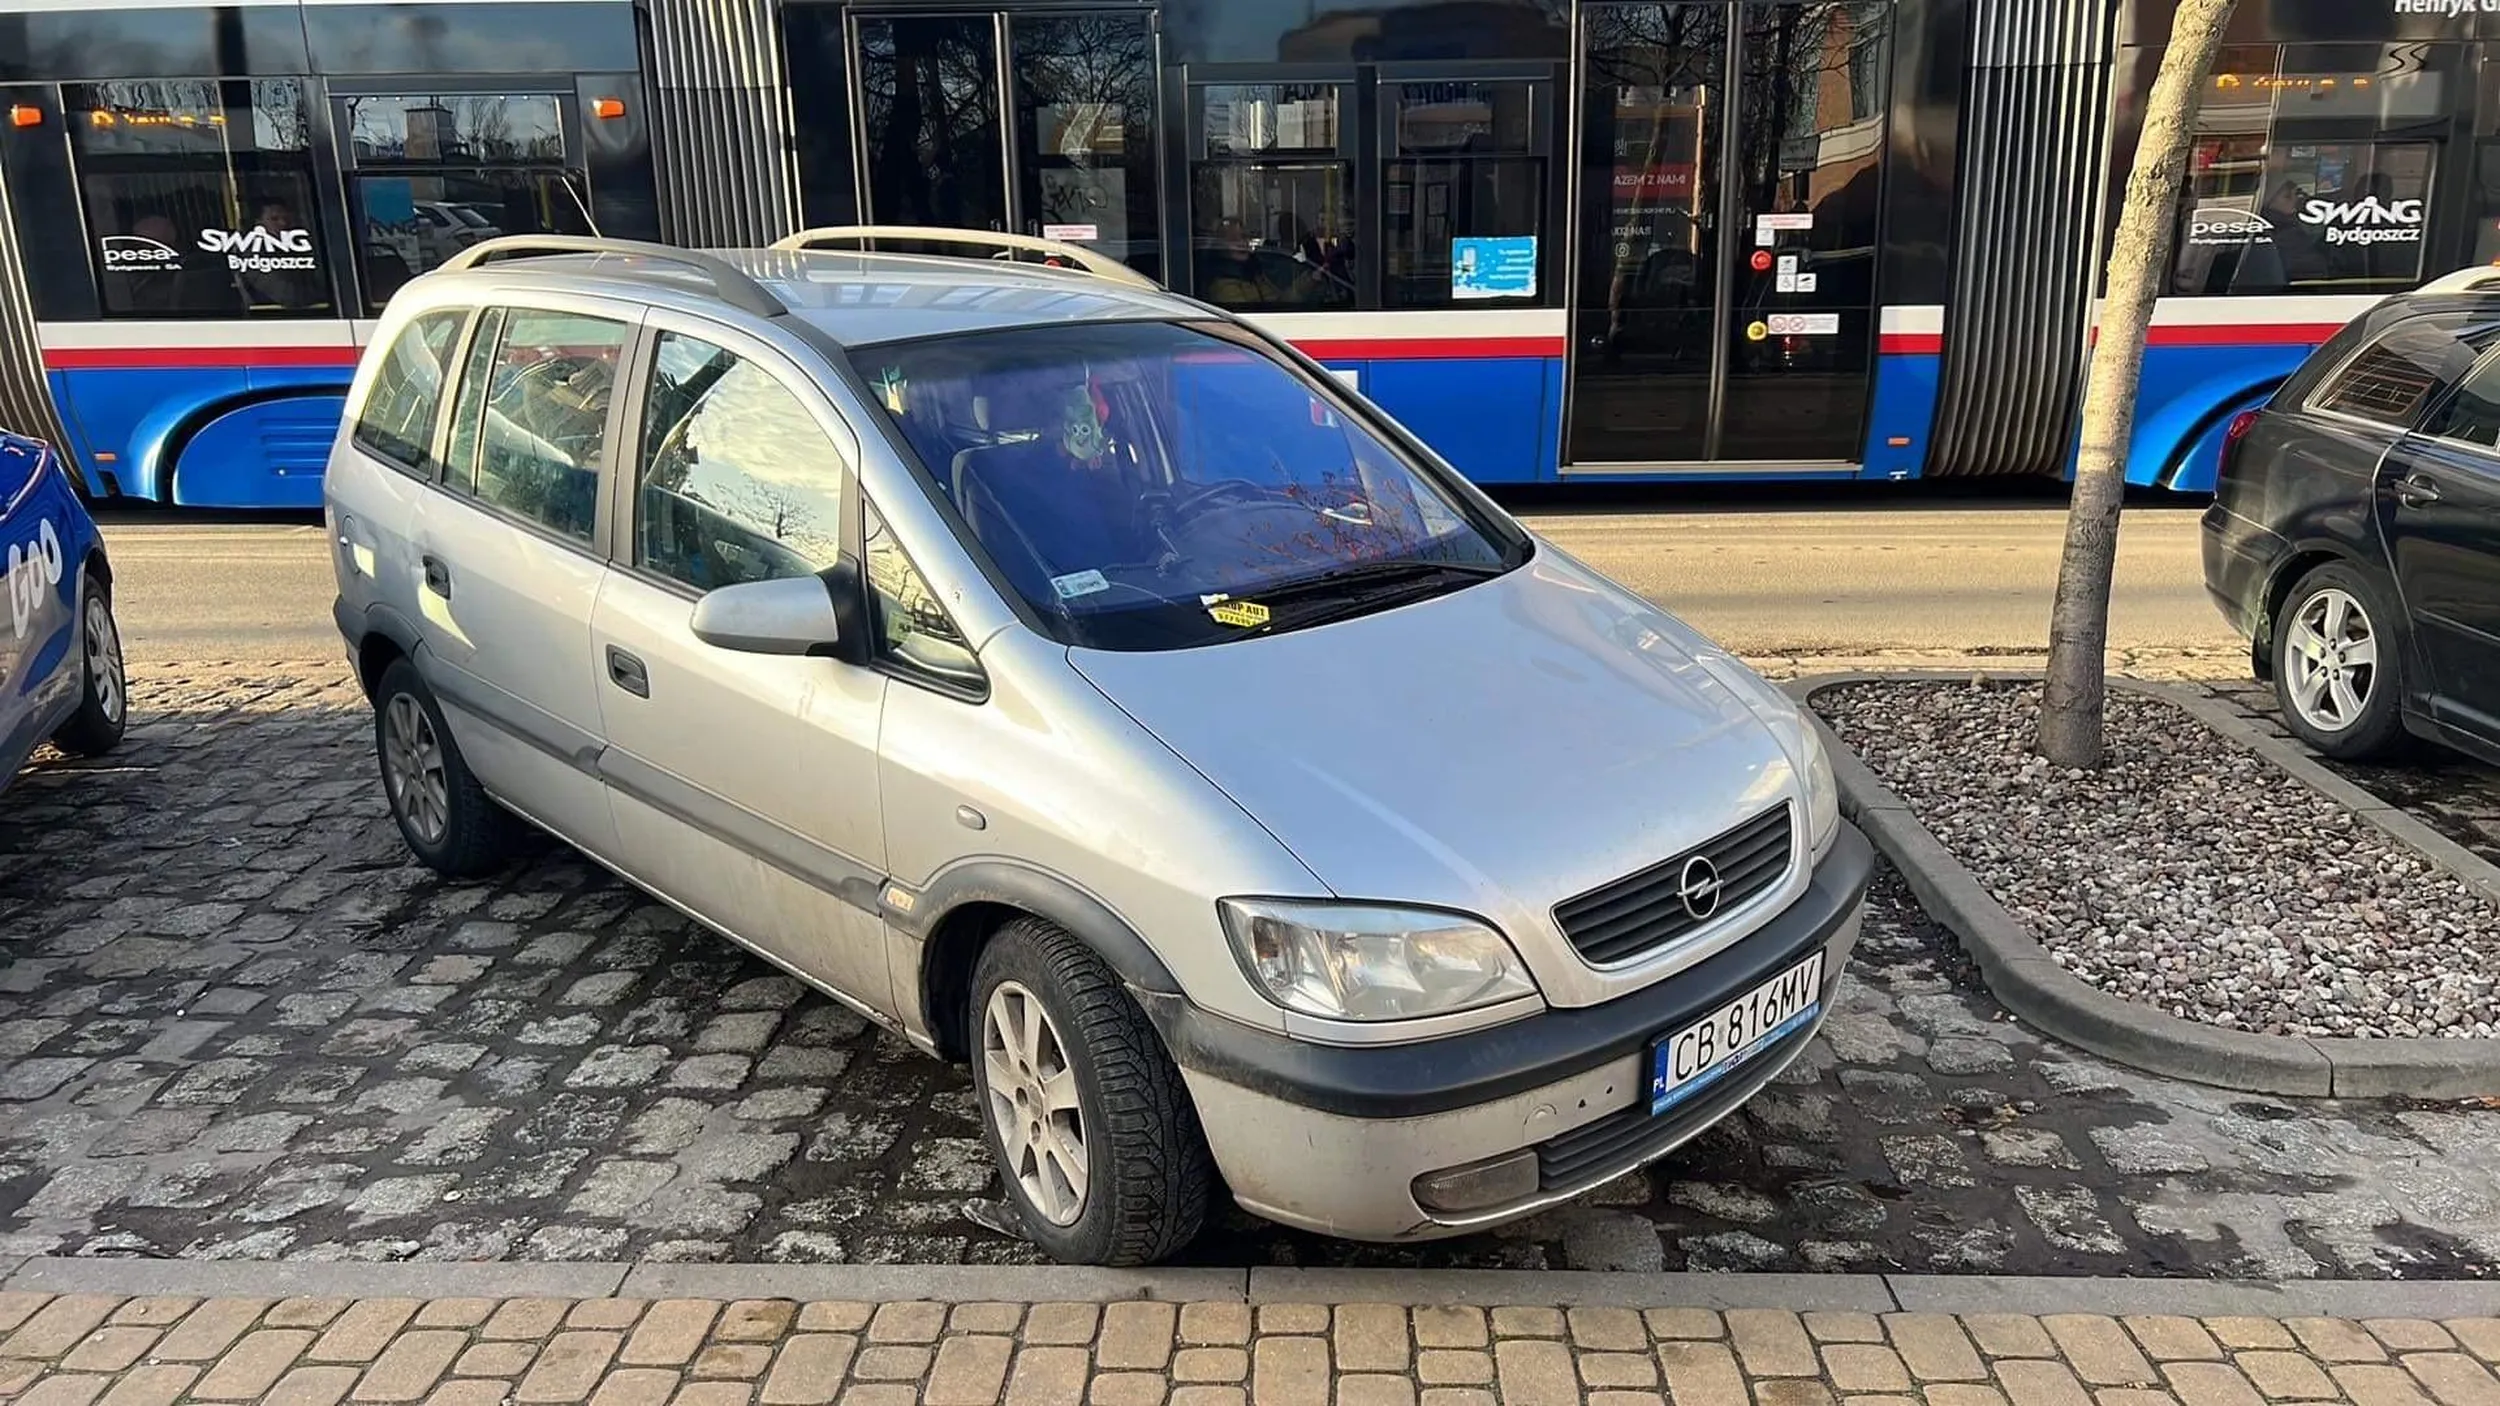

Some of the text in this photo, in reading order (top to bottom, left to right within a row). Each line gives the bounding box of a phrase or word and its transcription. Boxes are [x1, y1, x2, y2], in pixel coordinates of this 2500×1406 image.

[2481, 0, 2500, 12] G
[2189, 221, 2264, 237] pesa
[2326, 226, 2421, 246] Bydgoszcz
[104, 249, 172, 264] pesa
[227, 254, 316, 273] Bydgoszcz
[1675, 960, 1816, 1081] CB 816MV
[1653, 1078, 1665, 1093] PL
